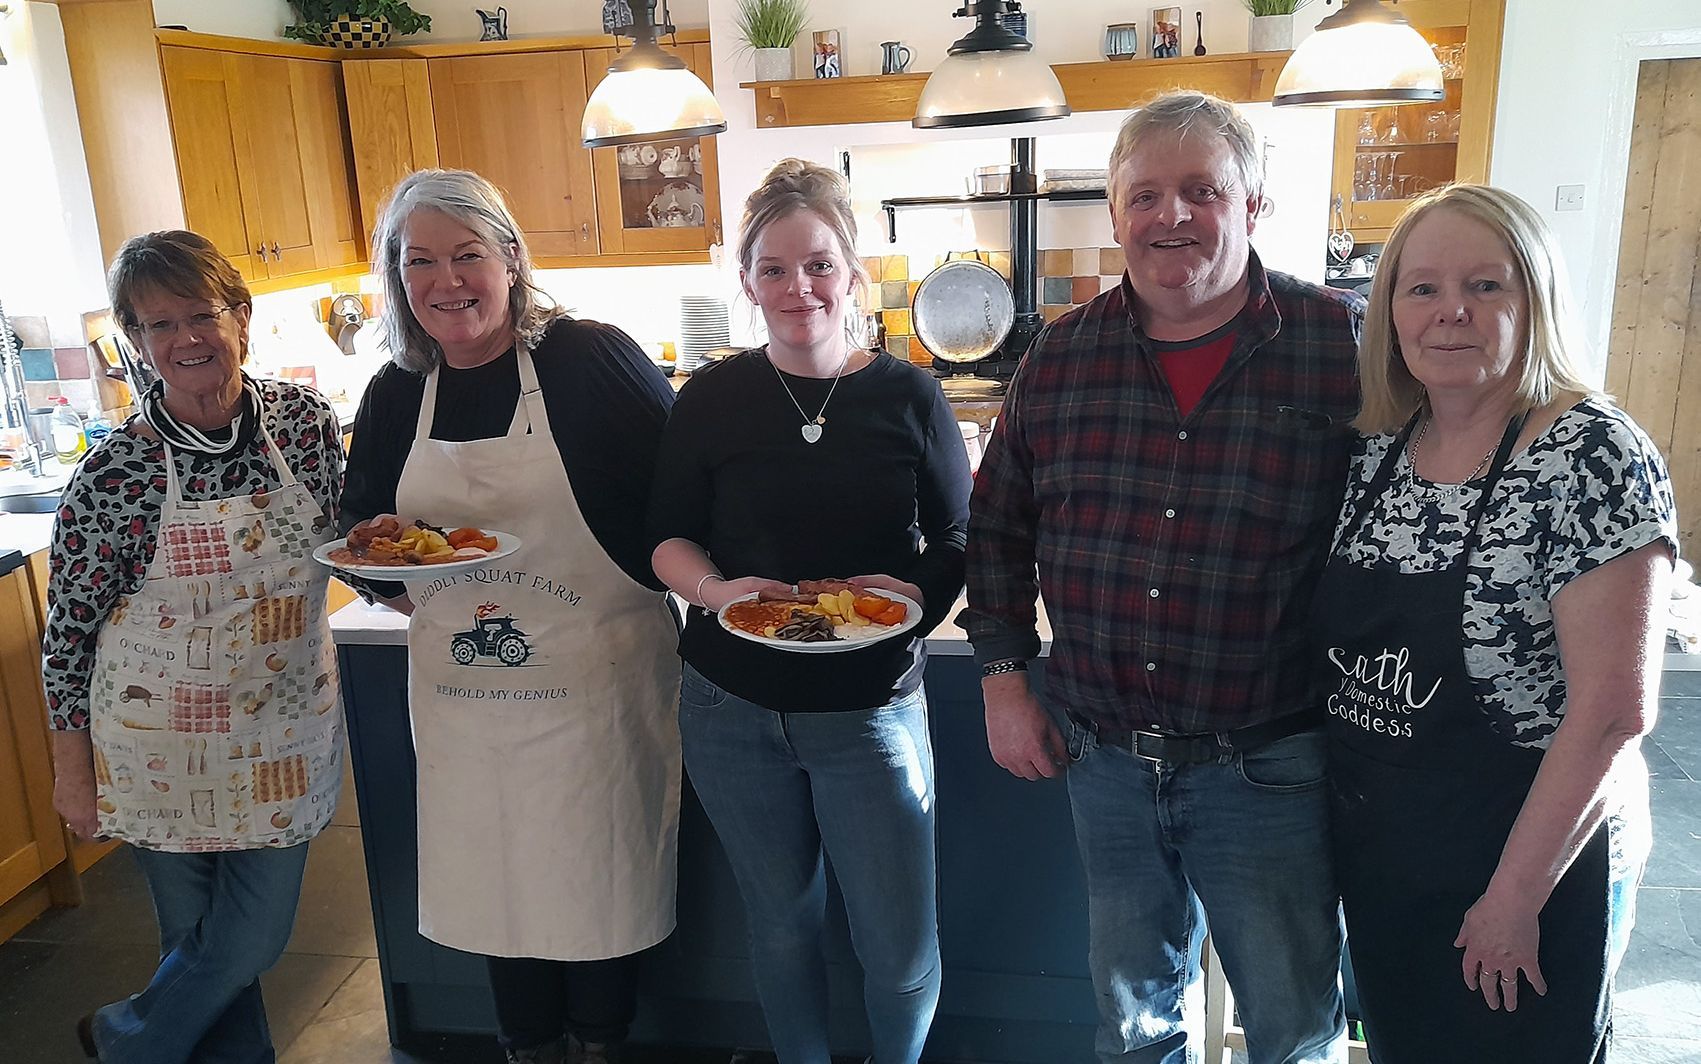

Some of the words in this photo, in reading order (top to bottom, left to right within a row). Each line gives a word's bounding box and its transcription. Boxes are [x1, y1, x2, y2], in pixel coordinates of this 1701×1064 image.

[464, 568, 527, 585] SQUAT
[531, 575, 583, 607] FARM
[119, 637, 176, 661] OCHAD
[435, 684, 485, 699] BEHOLD
[488, 689, 509, 700] MY
[513, 687, 568, 700] GENIUS
[1344, 680, 1413, 715] Domestic
[1327, 693, 1413, 738] Goddess
[122, 806, 184, 820] CHAD
